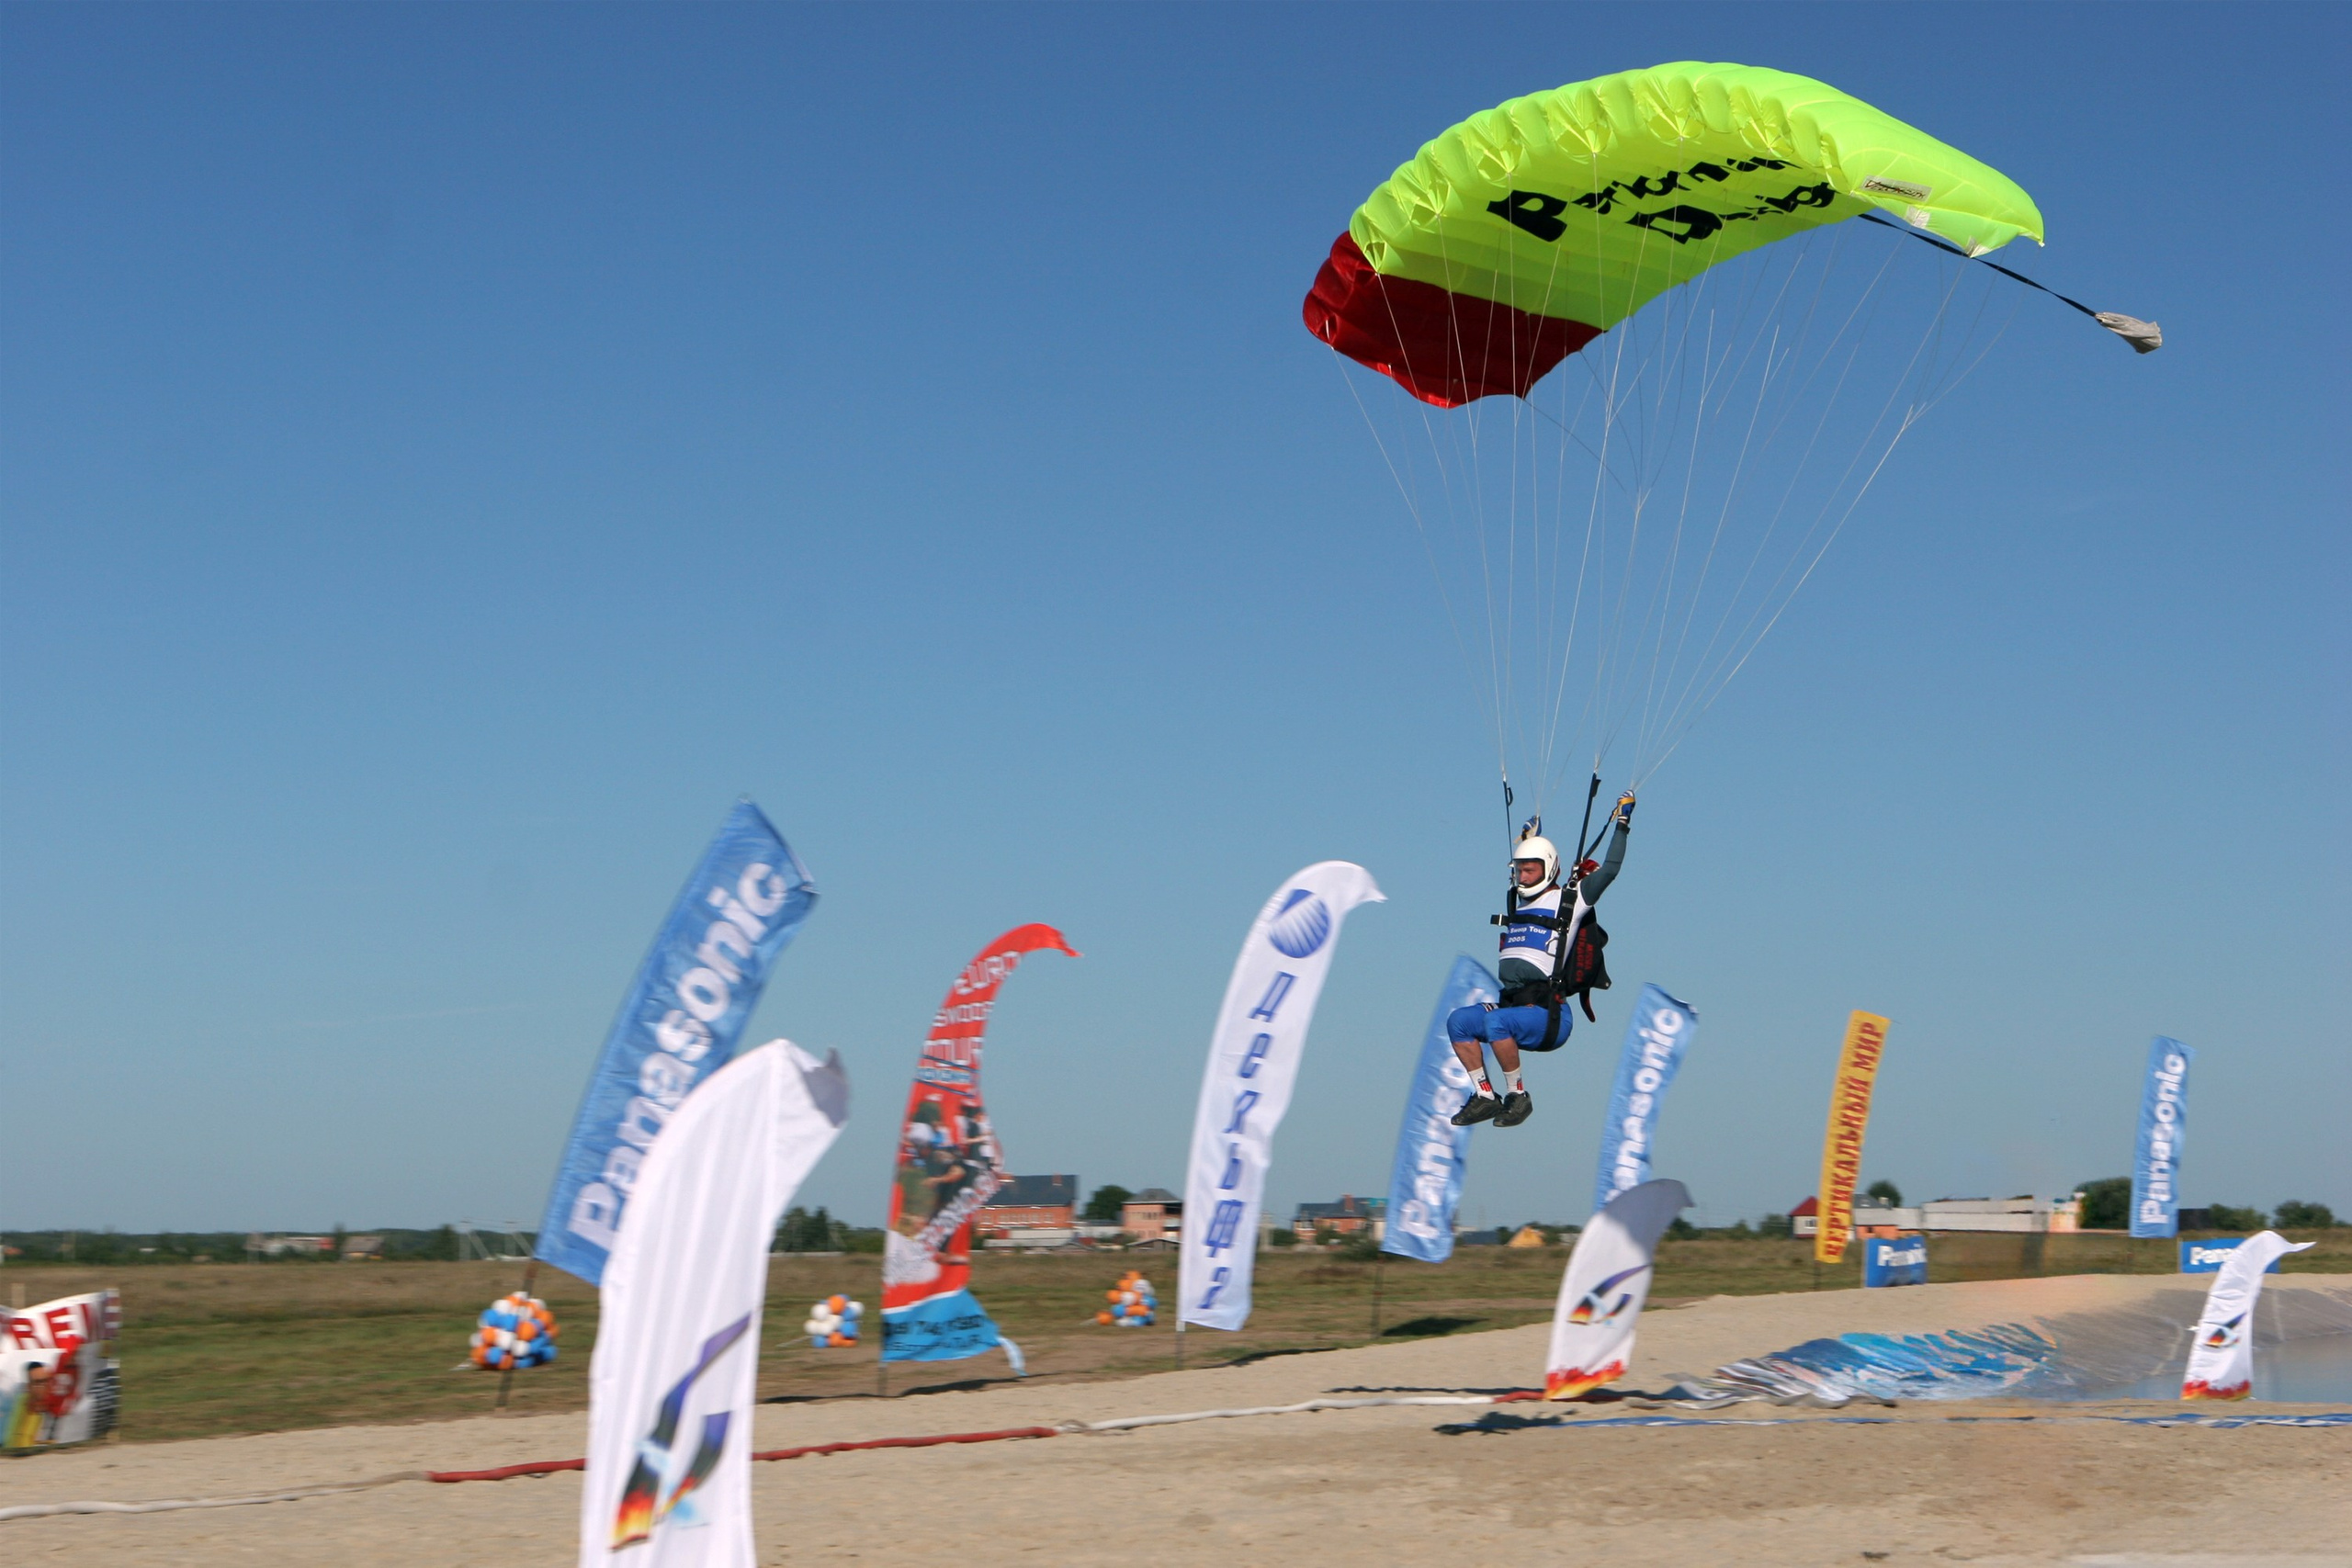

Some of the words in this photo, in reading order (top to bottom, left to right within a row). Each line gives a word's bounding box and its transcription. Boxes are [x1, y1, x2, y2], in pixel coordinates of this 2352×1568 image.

[1507, 935, 1526, 943] 2005
[1529, 925, 1547, 935] Tour
[567, 863, 788, 1252] Panasonic
[1850, 1021, 1883, 1073] МИР
[1604, 1008, 1684, 1201] anasonic
[2140, 1053, 2188, 1225] Panasonic
